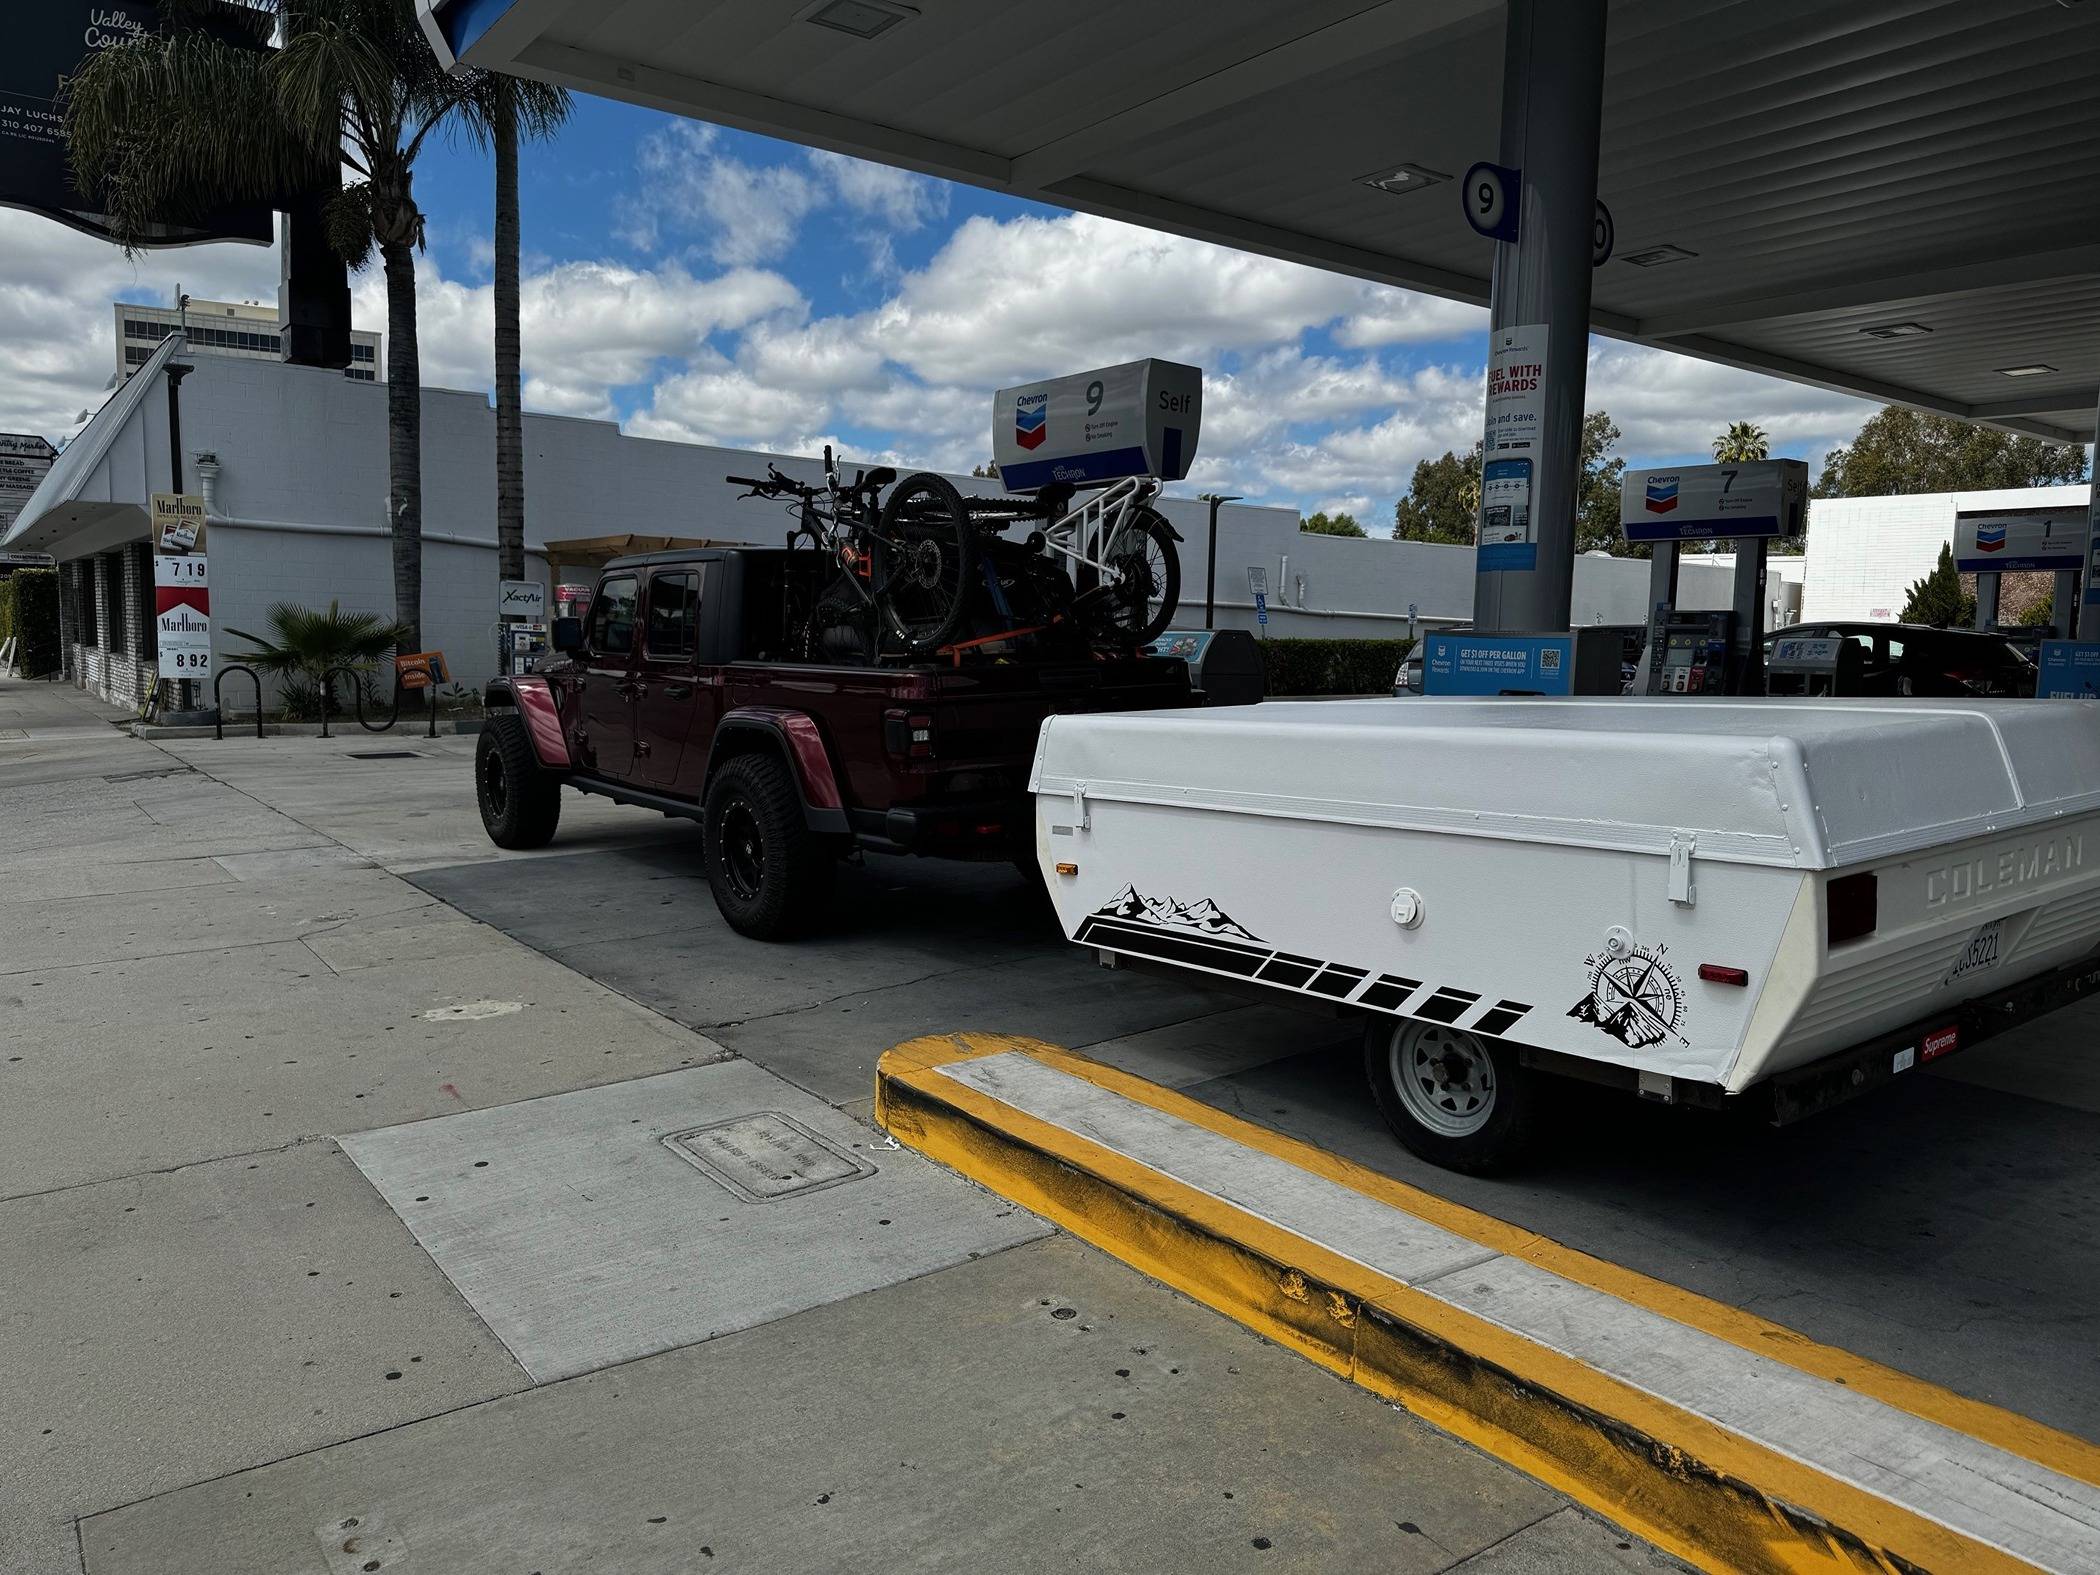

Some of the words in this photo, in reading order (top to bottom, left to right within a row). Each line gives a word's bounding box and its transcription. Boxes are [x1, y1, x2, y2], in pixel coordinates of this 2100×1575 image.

[90, 8, 145, 38] Valley
[1, 105, 22, 115] JAY
[26, 109, 64, 123] LUCHS
[1, 119, 20, 129] 310
[23, 123, 44, 133] 407
[1478, 182, 1494, 214] 9
[1509, 364, 1542, 378] WITH
[1488, 378, 1538, 396] REWARDS
[1017, 392, 1048, 407] Chevron
[1086, 380, 1104, 416] 9
[1159, 390, 1191, 413] Self
[1498, 413, 1511, 424] and
[1513, 413, 1537, 423] save.
[1647, 475, 1680, 485] Chevron
[1721, 470, 1738, 494] 7
[156, 497, 202, 515] Marlboro
[2044, 520, 2051, 538] 1
[502, 589, 542, 604] XactAir
[161, 612, 207, 632] Marlboro
[400, 658, 426, 667] Bitcoin
[1460, 649, 1470, 658] GET
[1478, 650, 1489, 659] OFF
[1489, 650, 1501, 659] PER
[1501, 650, 1527, 660] GALLON
[1926, 834, 2083, 909] COLEMAN
[1656, 943, 1669, 955] N
[1583, 953, 1596, 966] W
[1679, 1036, 1691, 1049] E
[1924, 1032, 1956, 1056] Supreme
